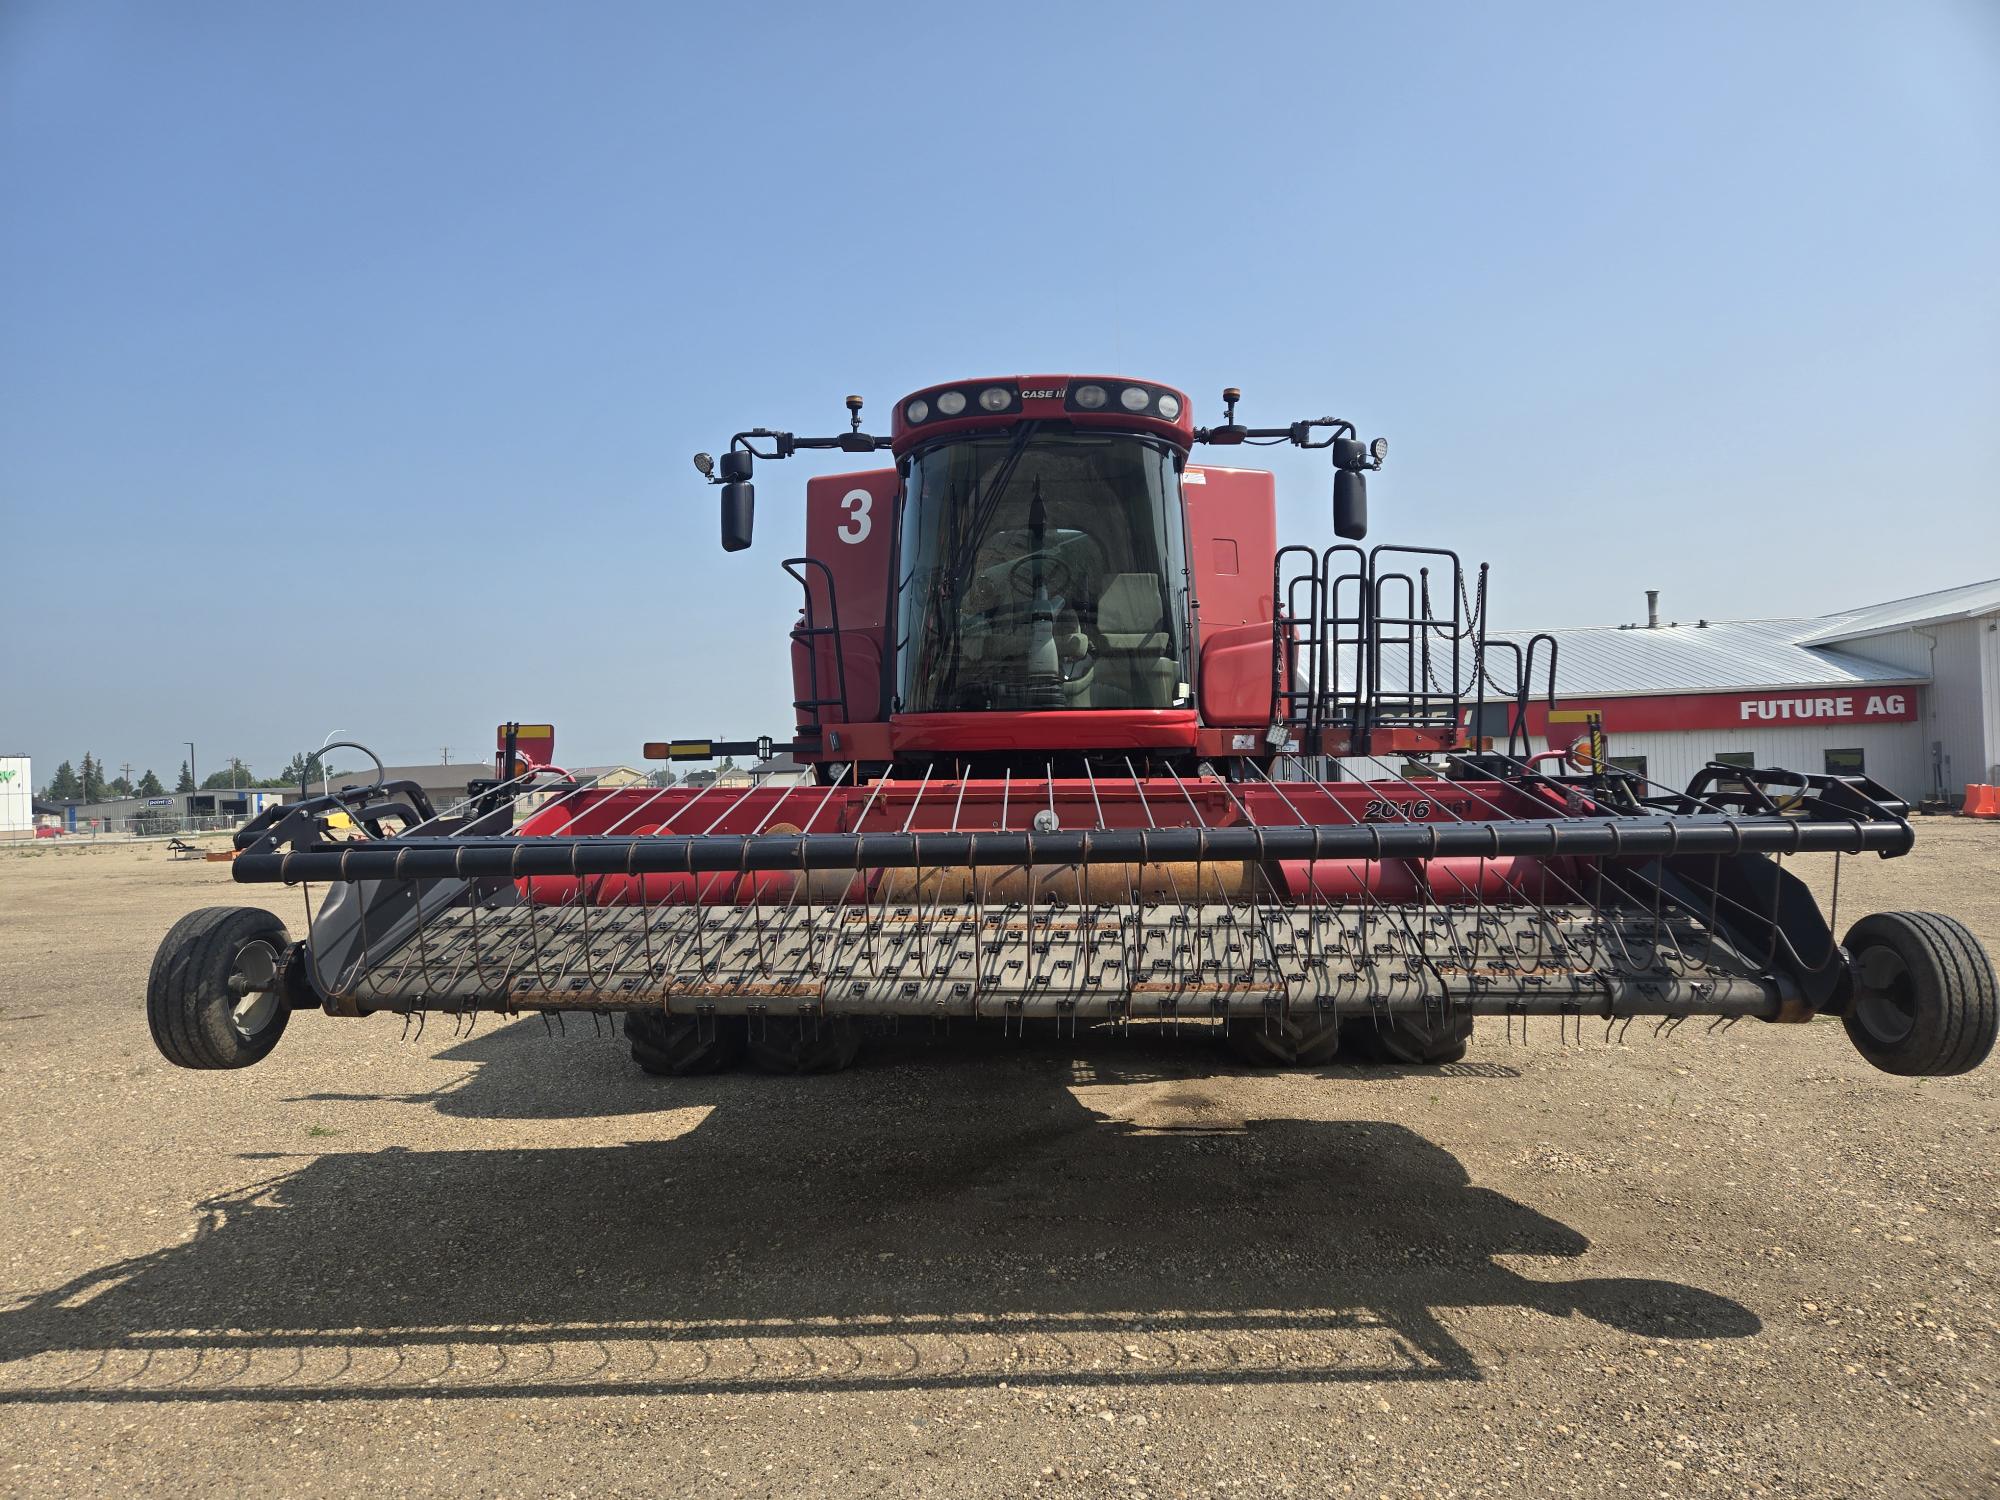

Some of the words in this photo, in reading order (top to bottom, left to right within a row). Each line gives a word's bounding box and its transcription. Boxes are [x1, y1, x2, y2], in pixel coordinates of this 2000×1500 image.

[1021, 390, 1054, 399] CASE
[837, 488, 873, 545] 3
[1740, 697, 1854, 720] FUTURE
[1864, 695, 1906, 715] AG
[1362, 799, 1431, 819] 2016
